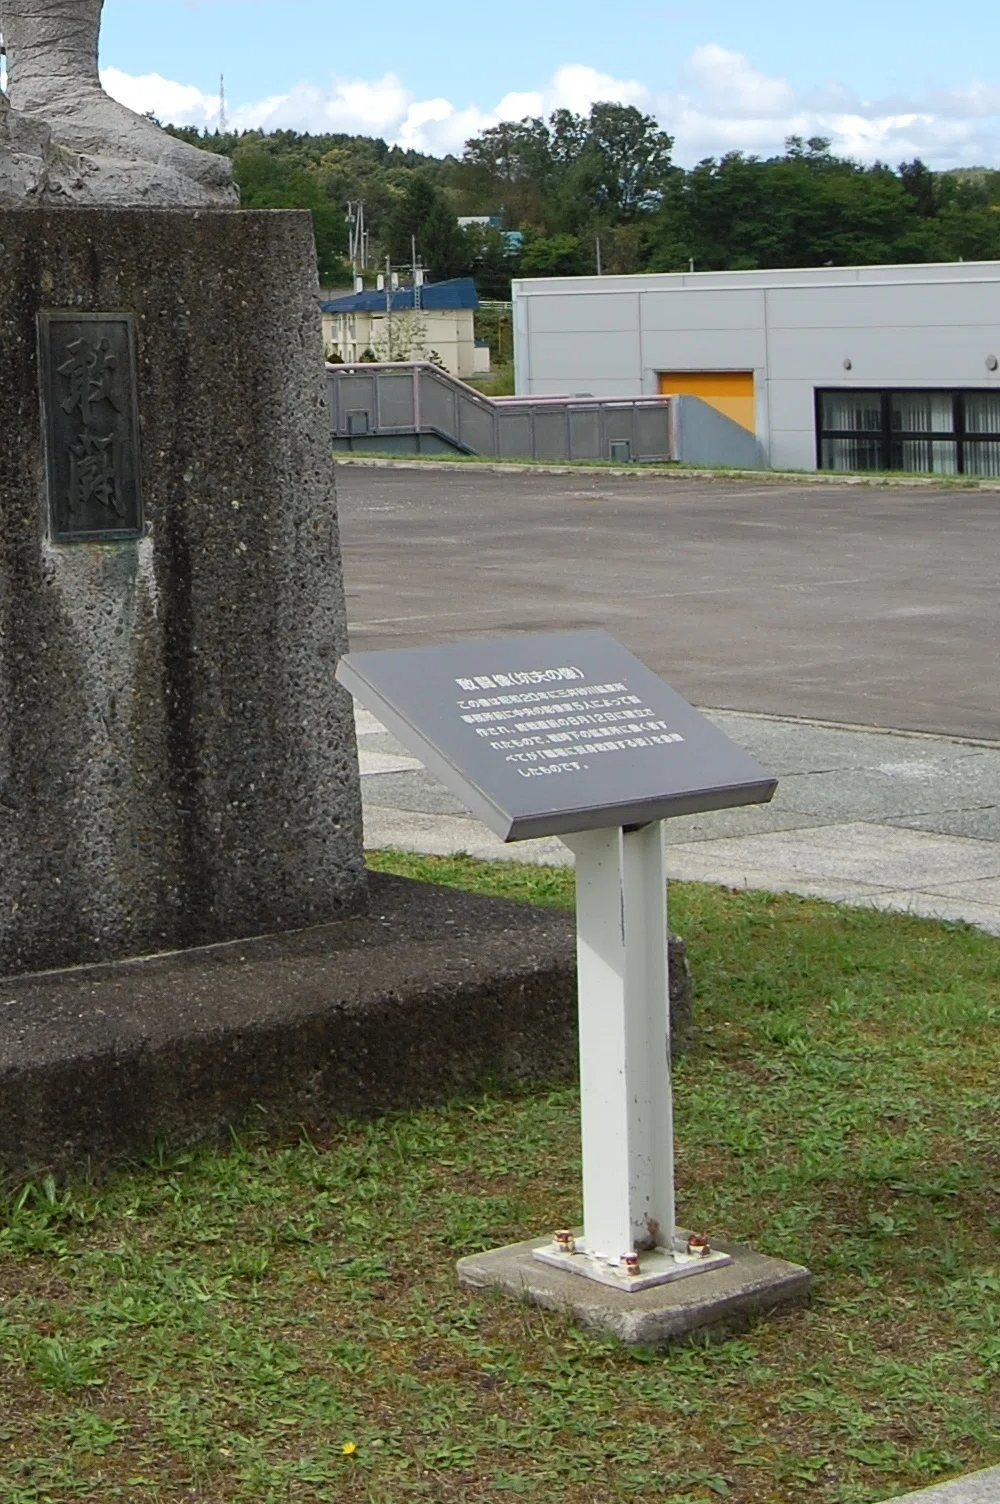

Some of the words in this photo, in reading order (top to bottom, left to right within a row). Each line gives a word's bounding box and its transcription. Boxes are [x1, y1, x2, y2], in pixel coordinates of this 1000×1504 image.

[518, 762, 590, 778] したものです。
